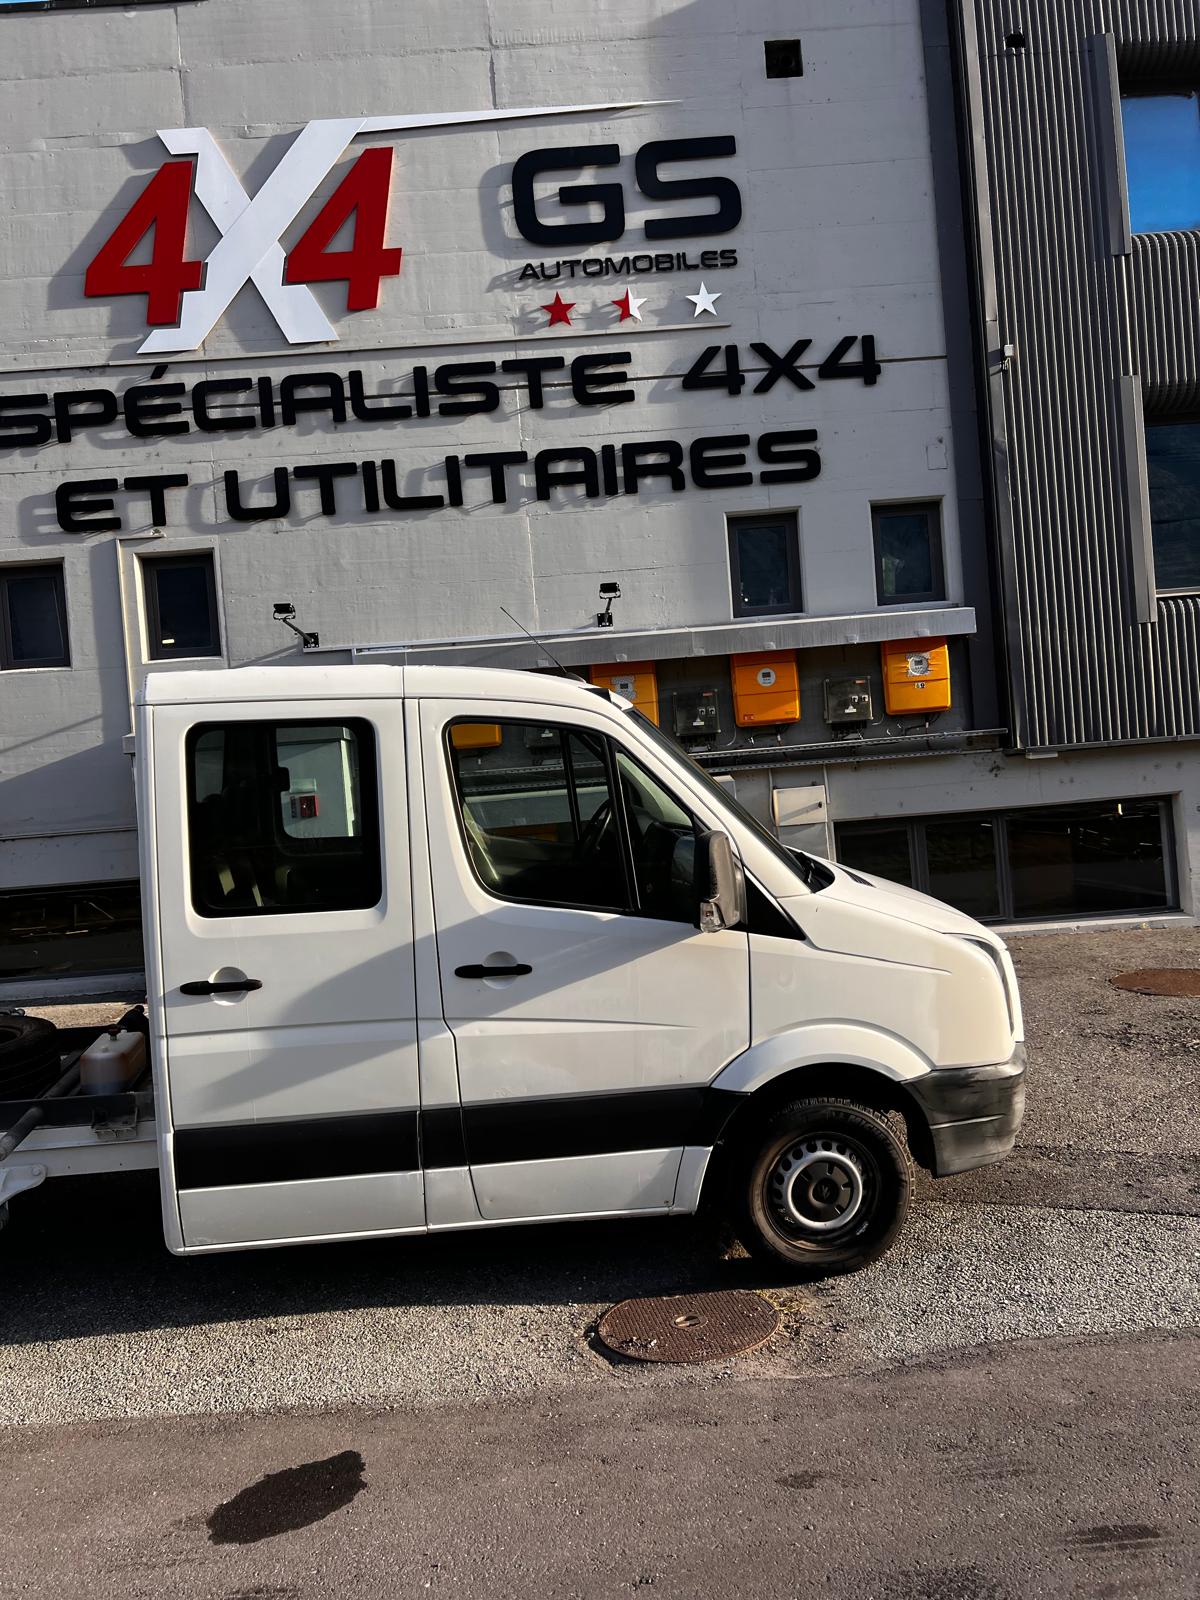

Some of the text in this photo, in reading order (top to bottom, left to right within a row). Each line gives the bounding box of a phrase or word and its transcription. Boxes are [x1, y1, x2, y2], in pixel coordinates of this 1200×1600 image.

[84, 119, 402, 354] 4X4
[512, 135, 742, 247] GS
[519, 249, 738, 281] AUTOMOBILES
[0, 335, 881, 449] SPÉCIALISTE 4X4
[56, 428, 821, 533] ET UTILITAIRES
